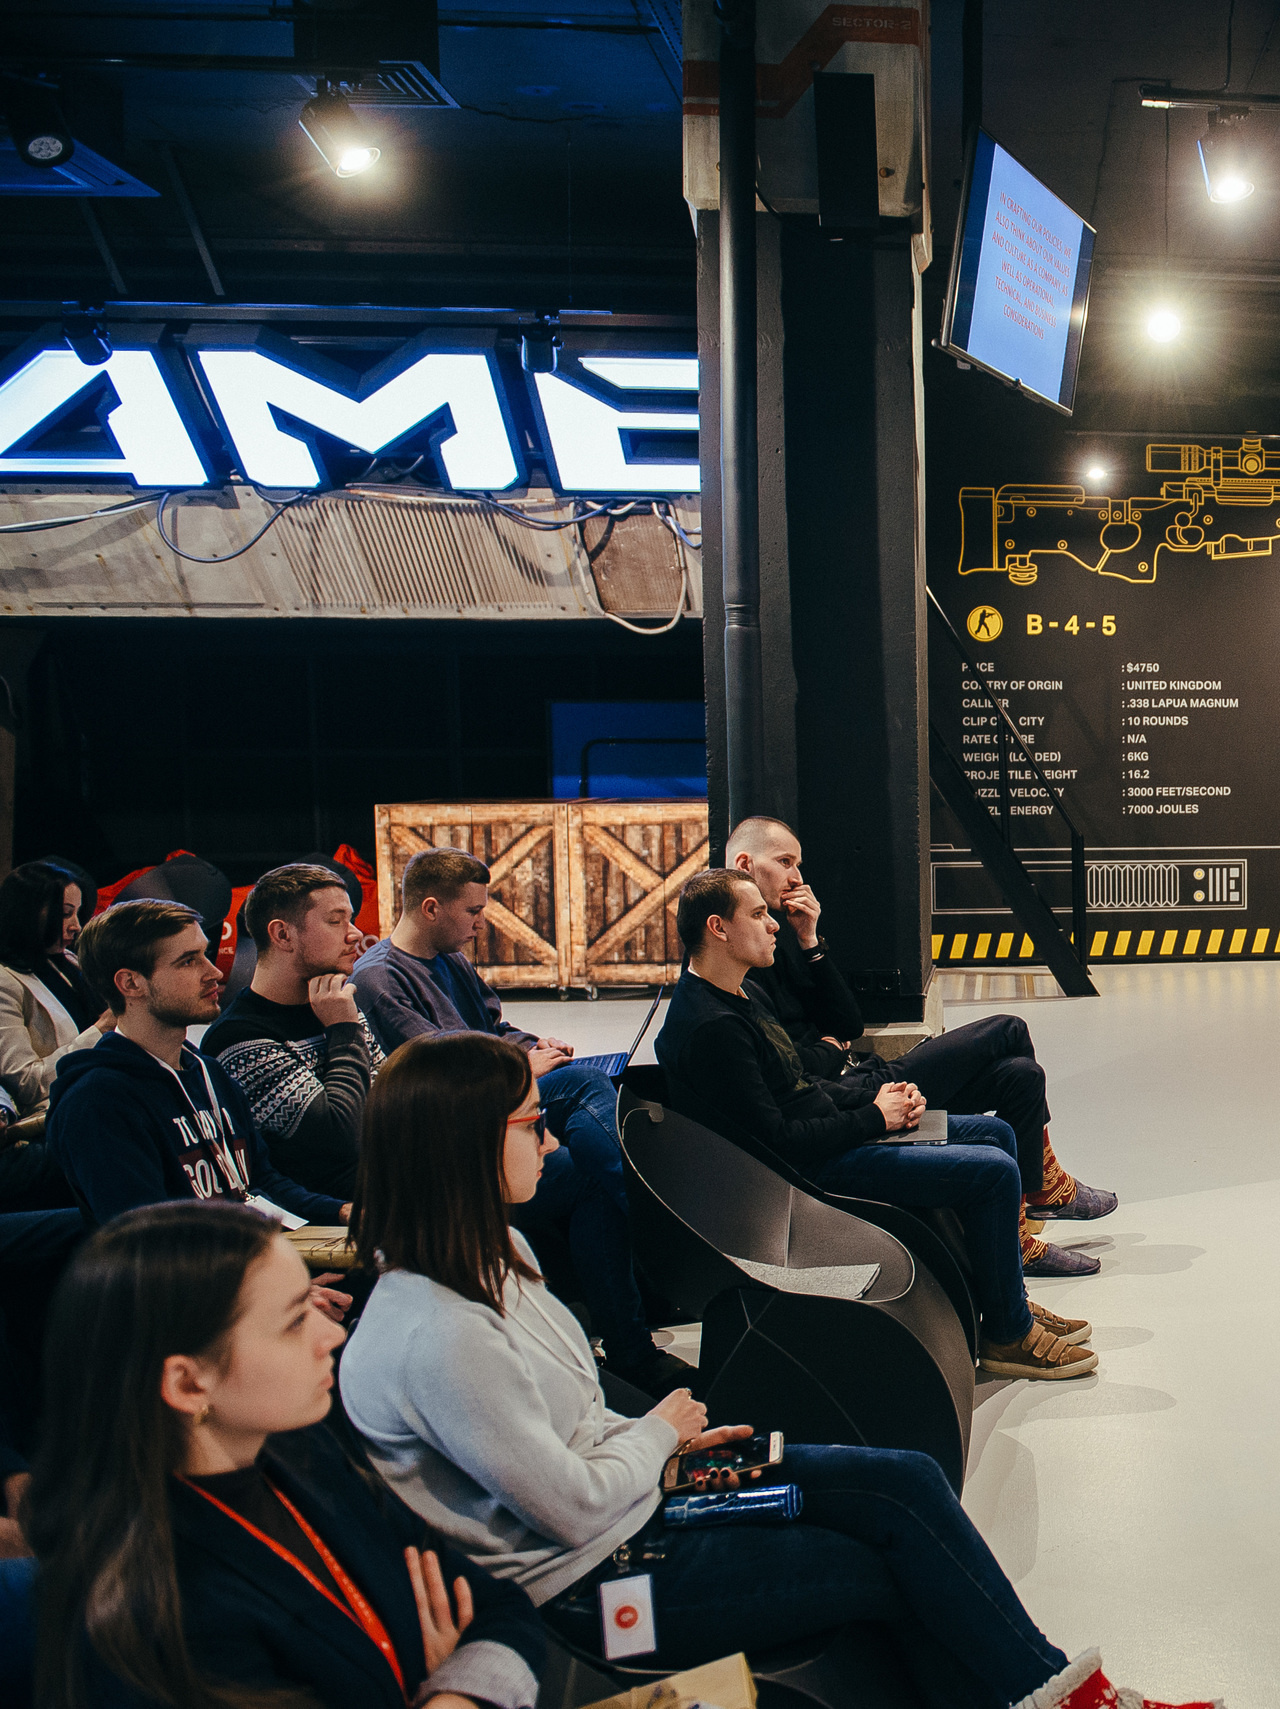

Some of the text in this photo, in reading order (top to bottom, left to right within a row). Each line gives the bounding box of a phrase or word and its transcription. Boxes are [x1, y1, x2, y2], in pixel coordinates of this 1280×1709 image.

[1000, 191, 1006, 206] IN
[1007, 197, 1031, 226] CRAFTING
[1032, 218, 1042, 235] OUR
[996, 210, 1070, 278] ALSO THINK ABOUT OUR VALUES
[992, 230, 1004, 248] AND
[1005, 240, 1026, 265] CULTURE
[1027, 257, 1033, 271] AS
[1062, 284, 1068, 297] AS
[1002, 258, 1014, 278] WELL
[1015, 270, 1022, 283] AS
[1024, 296, 1034, 312] AND
[1035, 304, 1056, 328] BUSINESS
[1003, 304, 1044, 340] CONSIDERATIONS
[962, 662, 994, 672] PICE
[1126, 662, 1160, 673] $4750
[962, 680, 1008, 690] COTRY
[1010, 680, 1025, 690] OF
[1027, 680, 1063, 690] ORGIN
[1126, 680, 1167, 690] UNITED
[1169, 680, 1222, 690] KINGDOM
[1151, 698, 1188, 708] LAPUA
[1189, 698, 1239, 708] MAGNUM
[962, 716, 988, 726] CLIP
[1127, 716, 1141, 726] 10
[1142, 716, 1189, 726] ROUNDS
[962, 734, 991, 744] RATE
[1127, 733, 1147, 744] N/A
[962, 752, 1000, 762] WEIGH
[1009, 751, 1062, 763] (LODED)
[1127, 751, 1149, 762] 6KG
[963, 770, 1032, 780] PROJETILE
[1127, 769, 1150, 779] 16.2
[1009, 787, 1065, 798] VELOCY
[1127, 787, 1154, 797] 3000
[1155, 786, 1232, 797] FEET/SECOND
[1010, 805, 1054, 816] ENERGY
[1127, 804, 1154, 815] 7000
[1155, 804, 1199, 815] JOULES
